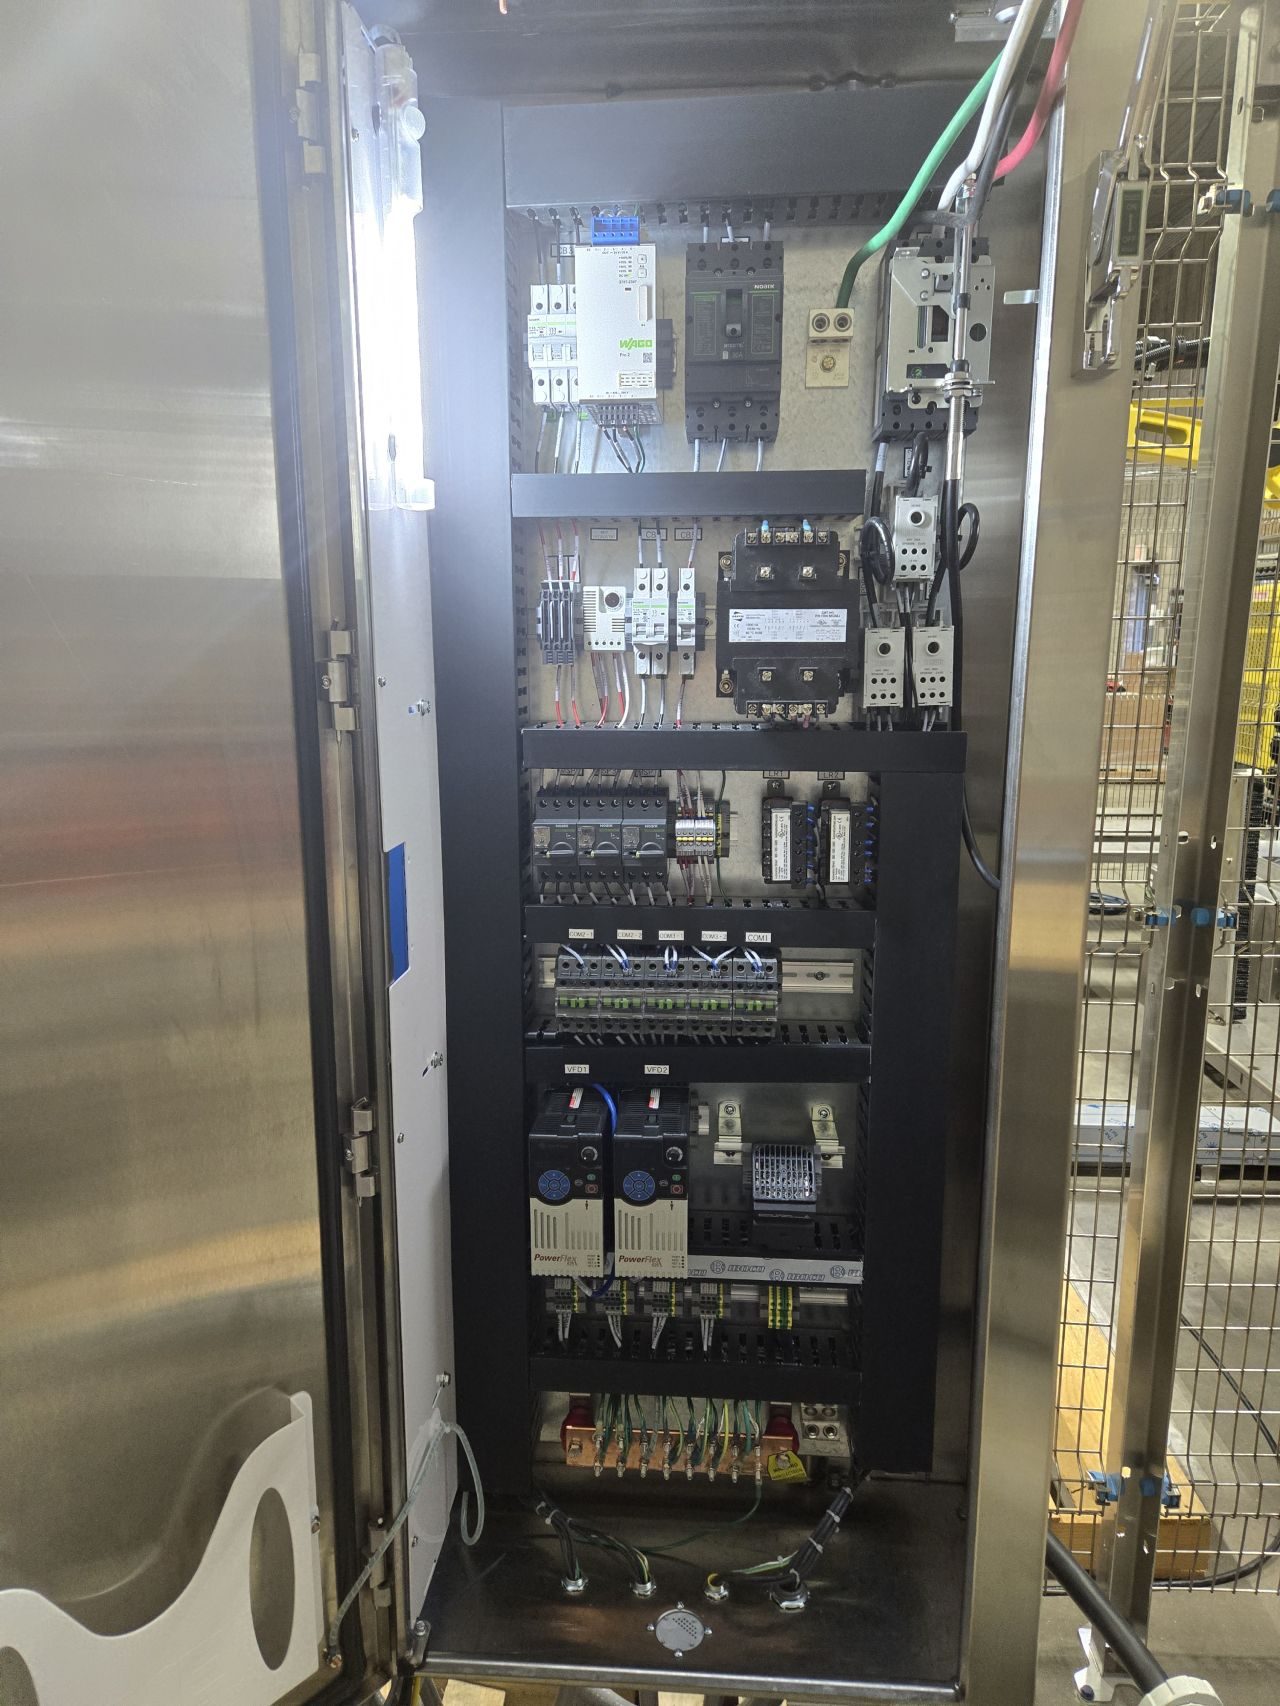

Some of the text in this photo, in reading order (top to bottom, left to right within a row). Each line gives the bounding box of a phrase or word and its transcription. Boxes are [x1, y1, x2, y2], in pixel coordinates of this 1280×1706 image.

[619, 337, 653, 351] WAGO
[747, 934, 769, 942] COM1
[534, 1253, 578, 1265] PowerFlex
[619, 1254, 662, 1266] PowerFlex
